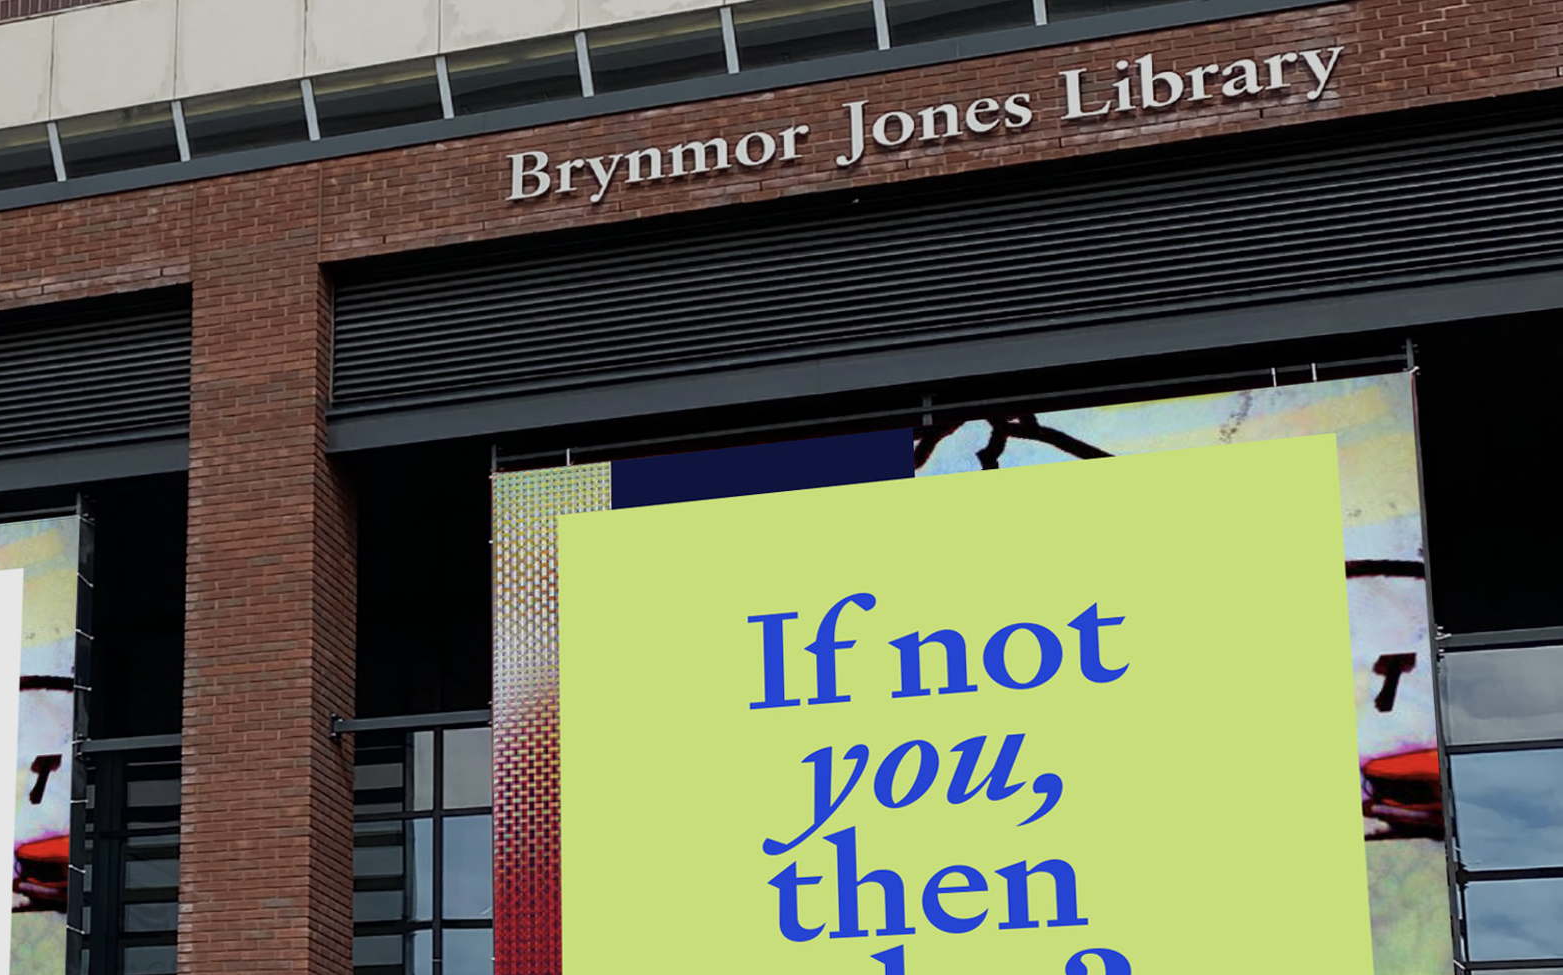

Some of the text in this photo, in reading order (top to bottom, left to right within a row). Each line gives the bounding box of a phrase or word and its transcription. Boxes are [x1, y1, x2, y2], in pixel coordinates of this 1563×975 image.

[506, 46, 1344, 204] Brynmor Jones Library
[747, 592, 1130, 711] If not
[762, 733, 1064, 856] you,
[767, 825, 1089, 943] then
